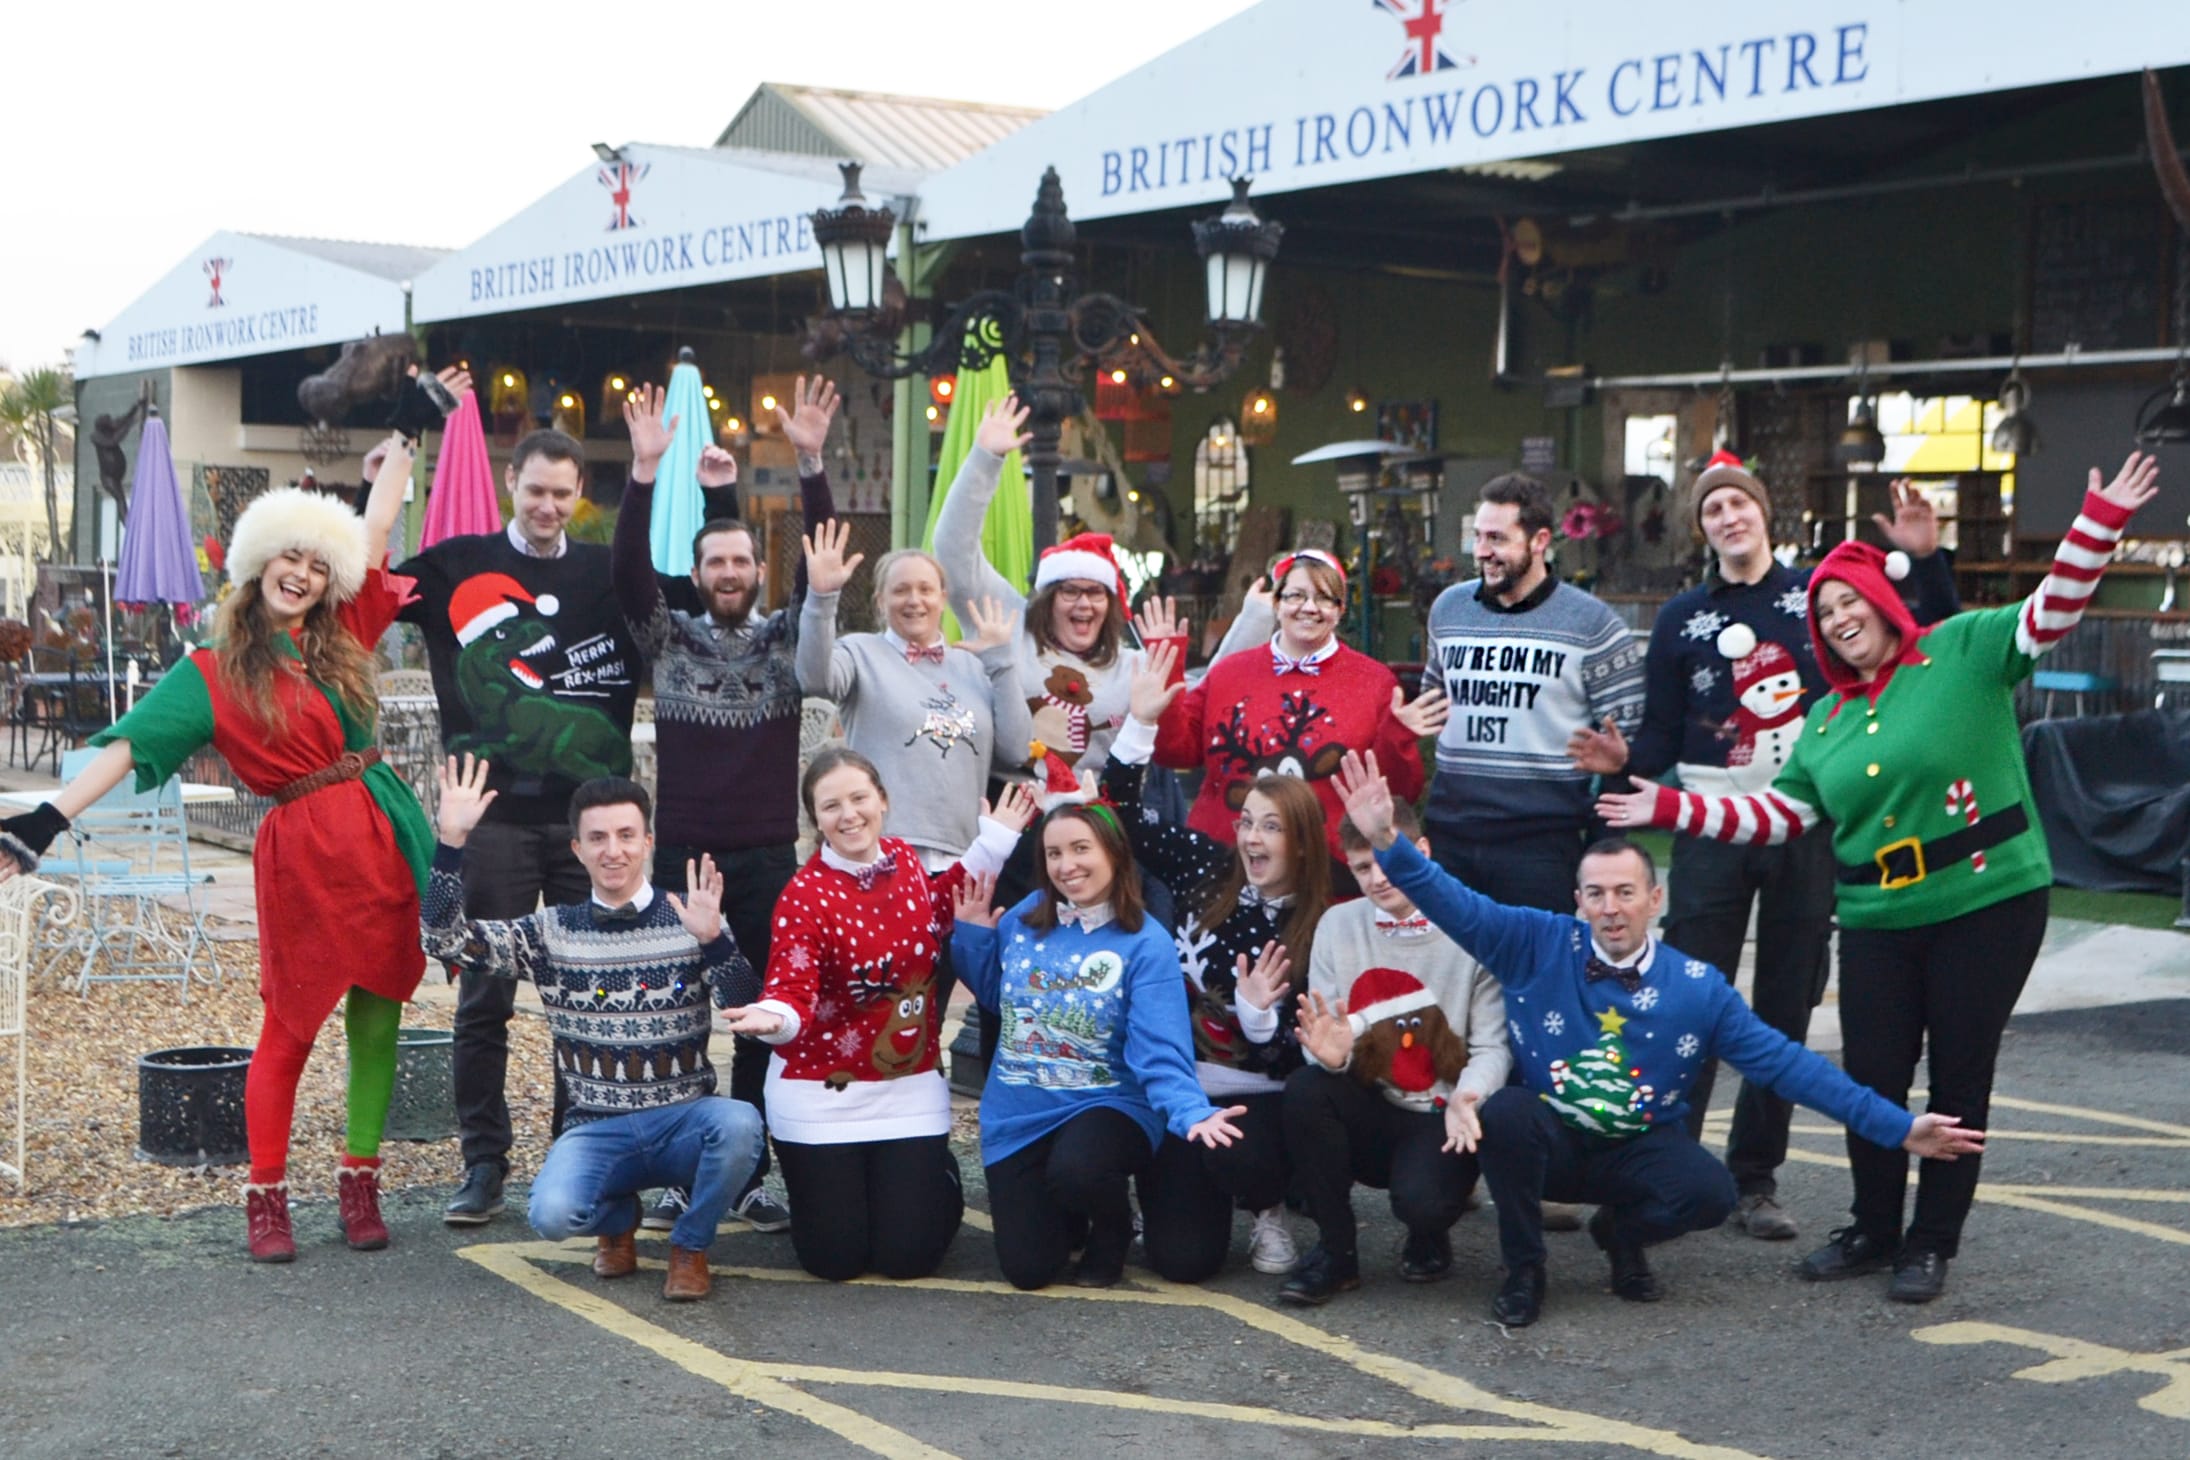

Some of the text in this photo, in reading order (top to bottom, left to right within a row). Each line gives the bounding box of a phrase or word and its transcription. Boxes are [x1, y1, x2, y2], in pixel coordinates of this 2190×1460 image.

[1101, 23, 1869, 195] BRITISH IRONWORK CENTRE
[471, 212, 811, 302] BRITISH IRONWORK CENTRE
[128, 304, 319, 361] BRITISH IRONWORK CENTRE
[568, 638, 615, 667] MERRY
[1500, 646, 1528, 672] ON
[1532, 649, 1567, 679] MY
[1450, 679, 1541, 710] NAUGHTY
[1466, 715, 1508, 744] LIST
